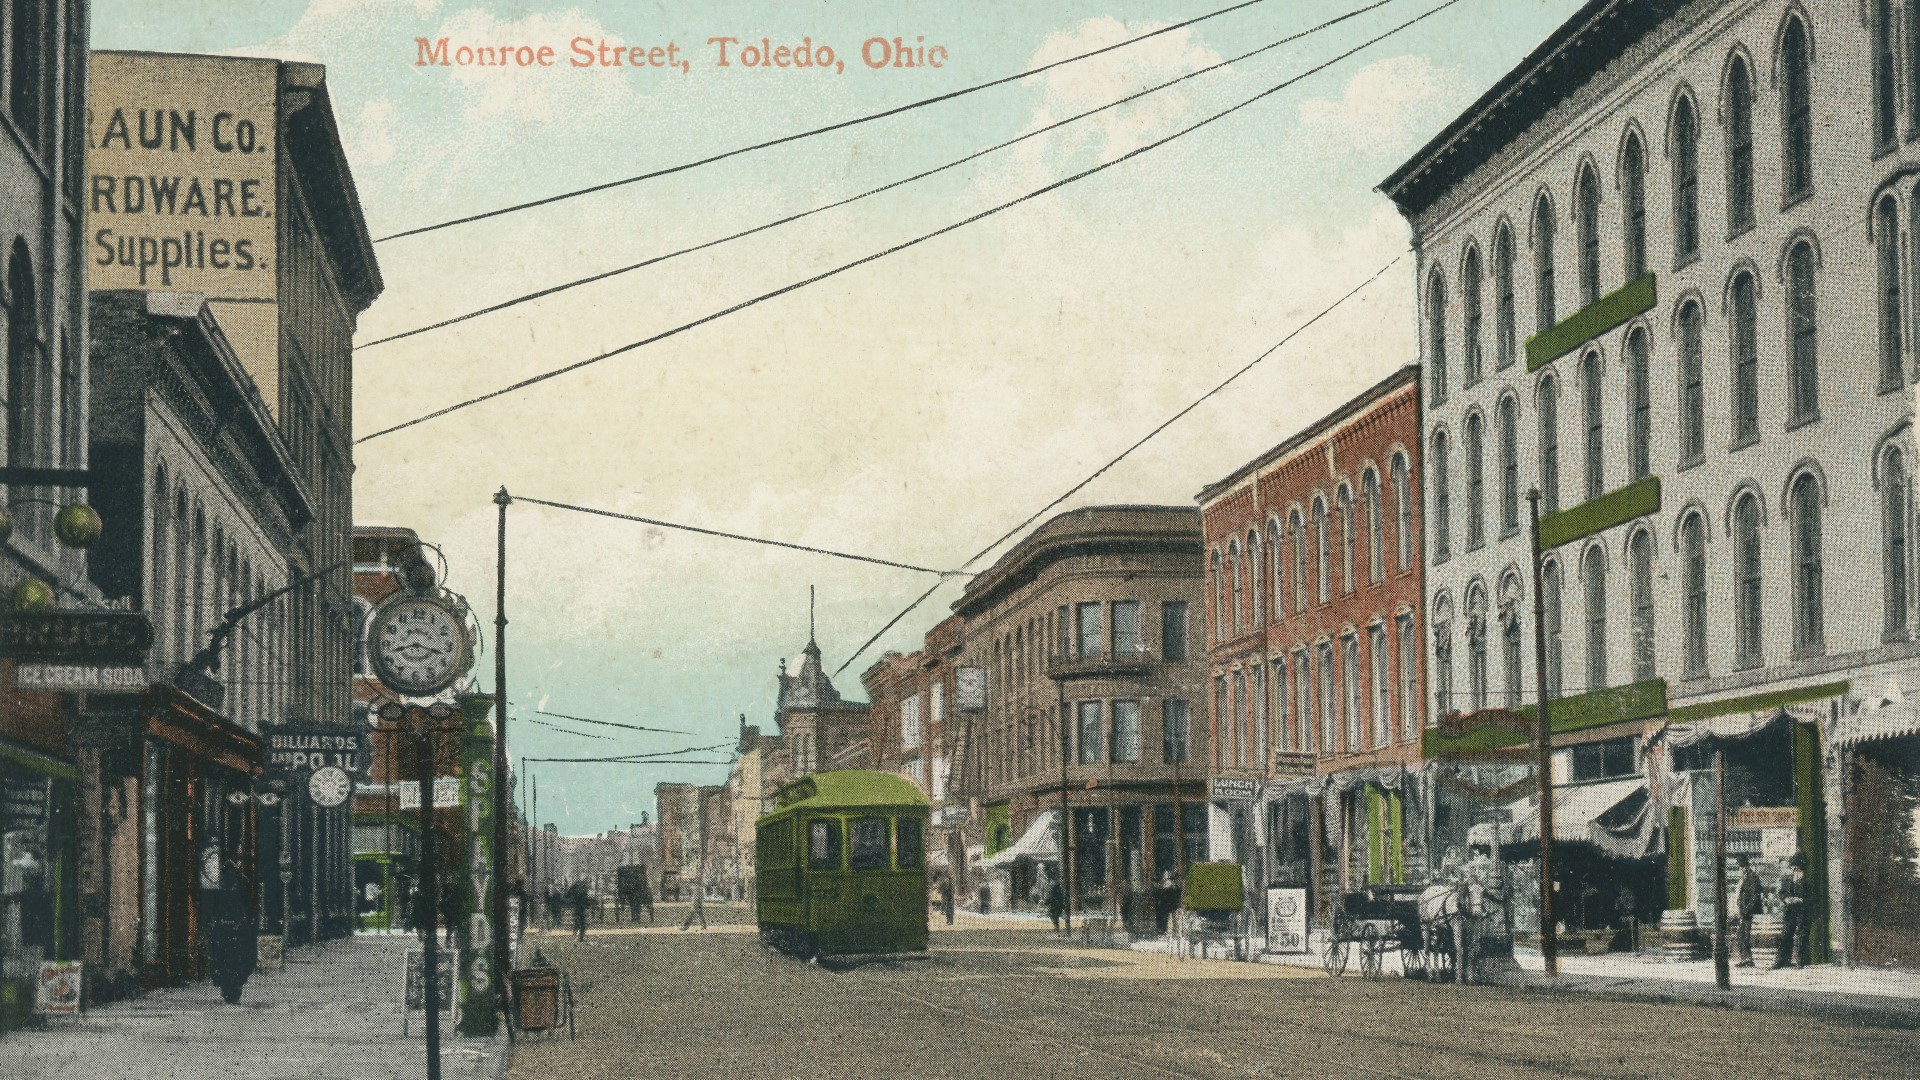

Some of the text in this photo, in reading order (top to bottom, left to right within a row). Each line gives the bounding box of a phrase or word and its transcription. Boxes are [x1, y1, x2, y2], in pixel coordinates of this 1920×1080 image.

[211, 112, 266, 154] Co.
[91, 174, 273, 218] RDWARE.
[95, 228, 268, 286] Supplies.
[45, 666, 99, 686] CREAM
[102, 667, 146, 687] SODA
[272, 735, 358, 751] BILLIARDS
[1214, 778, 1253, 789] LUNCH
